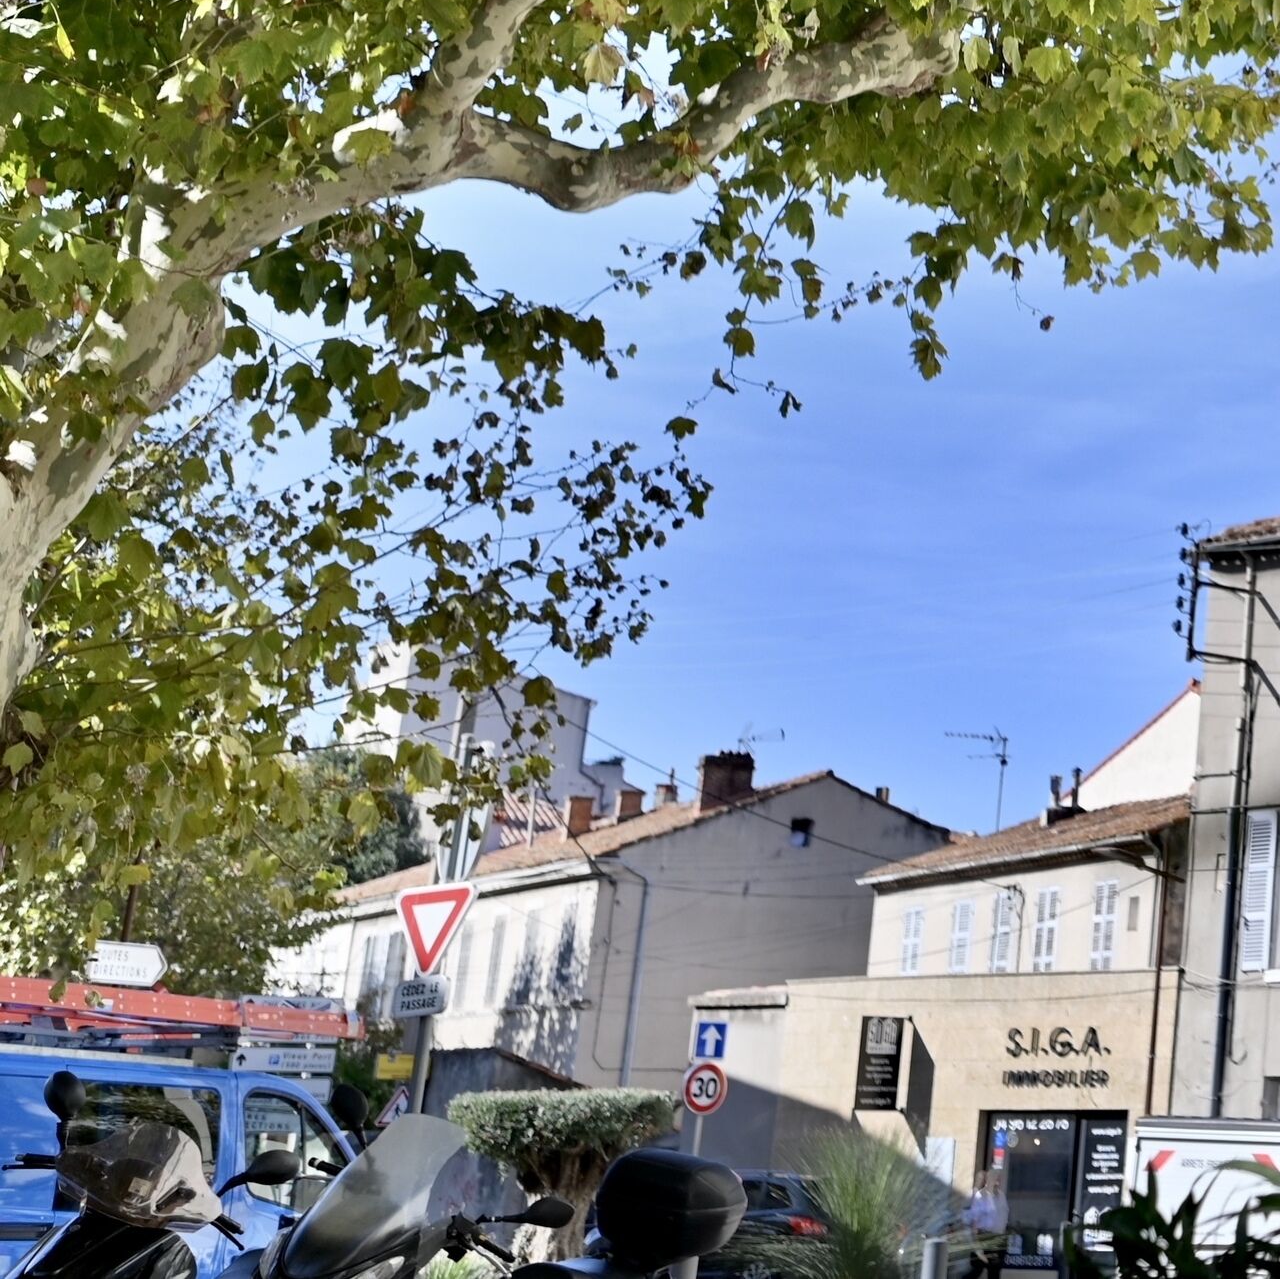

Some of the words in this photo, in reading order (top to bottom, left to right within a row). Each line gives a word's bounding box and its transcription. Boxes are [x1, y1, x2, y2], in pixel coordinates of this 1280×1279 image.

[92, 964, 149, 979] DIRECTIONS
[430, 981, 440, 993] LE
[400, 997, 438, 1011] PASSAGE
[1005, 1026, 1112, 1058] S.I.G.A.
[1002, 1069, 1110, 1089] IMMOBILIER
[692, 1077, 718, 1099] 30
